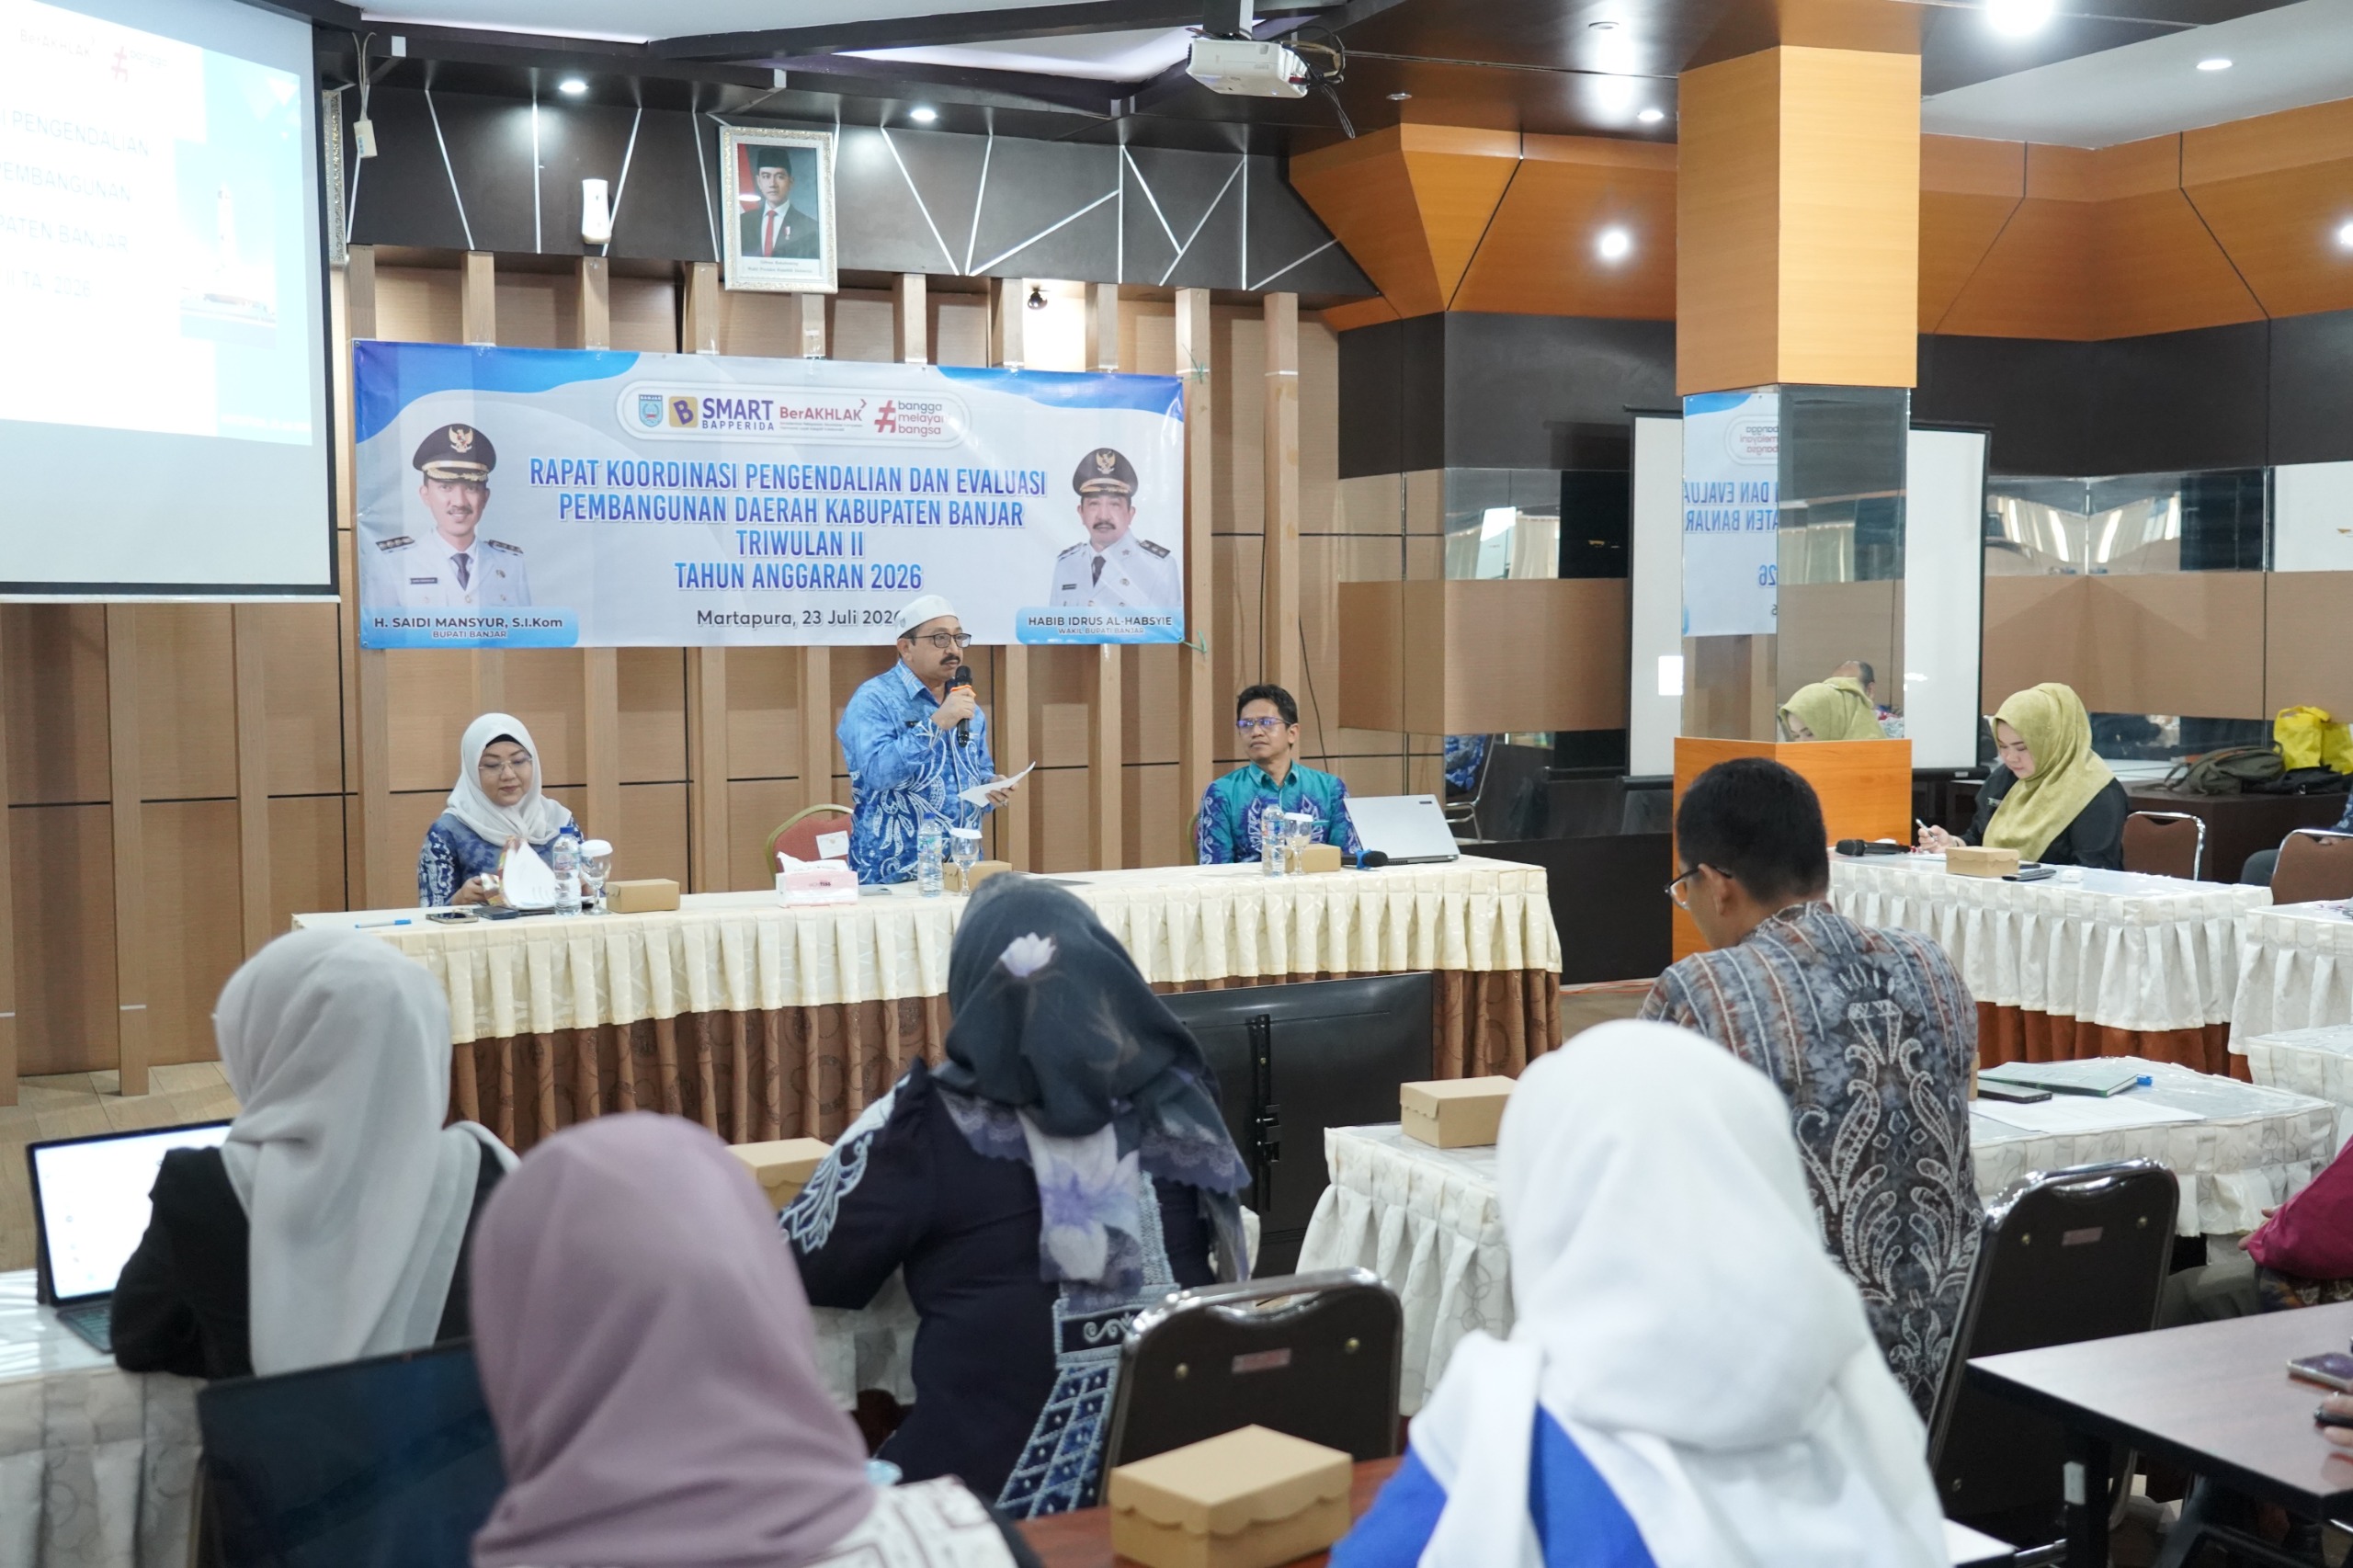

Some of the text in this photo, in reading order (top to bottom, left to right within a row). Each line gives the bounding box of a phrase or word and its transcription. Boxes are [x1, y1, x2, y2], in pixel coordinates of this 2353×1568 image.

[12, 109, 150, 158] PENGENDALIAN
[0, 161, 131, 203] EMBANGUNAN
[58, 223, 130, 255] BANJAR
[702, 397, 774, 420] SMART
[779, 406, 862, 422] BerAKHLAK
[898, 401, 942, 414] bangga
[702, 419, 774, 430] BAPPERIDA
[898, 414, 946, 426] melaya
[898, 424, 941, 437] bangsa
[529, 458, 1046, 495] RAPAT KOORDINASI PENGENDALIAN DAN EVALUASI
[559, 493, 1023, 527] PEMBANGUNAN DAERAH KABUPATEN BANJAR
[735, 529, 864, 556] TRIWULAN II
[674, 562, 923, 590] TAHUN ANGGARAN 2026
[374, 618, 563, 630] H. SAIDI MANSYUR, S.I.Kom
[697, 609, 797, 628] Martapura,
[802, 609, 822, 625] 23
[827, 609, 857, 625] Juli
[1029, 617, 1172, 626] HABIB IDRUS AL-HABSYIE
